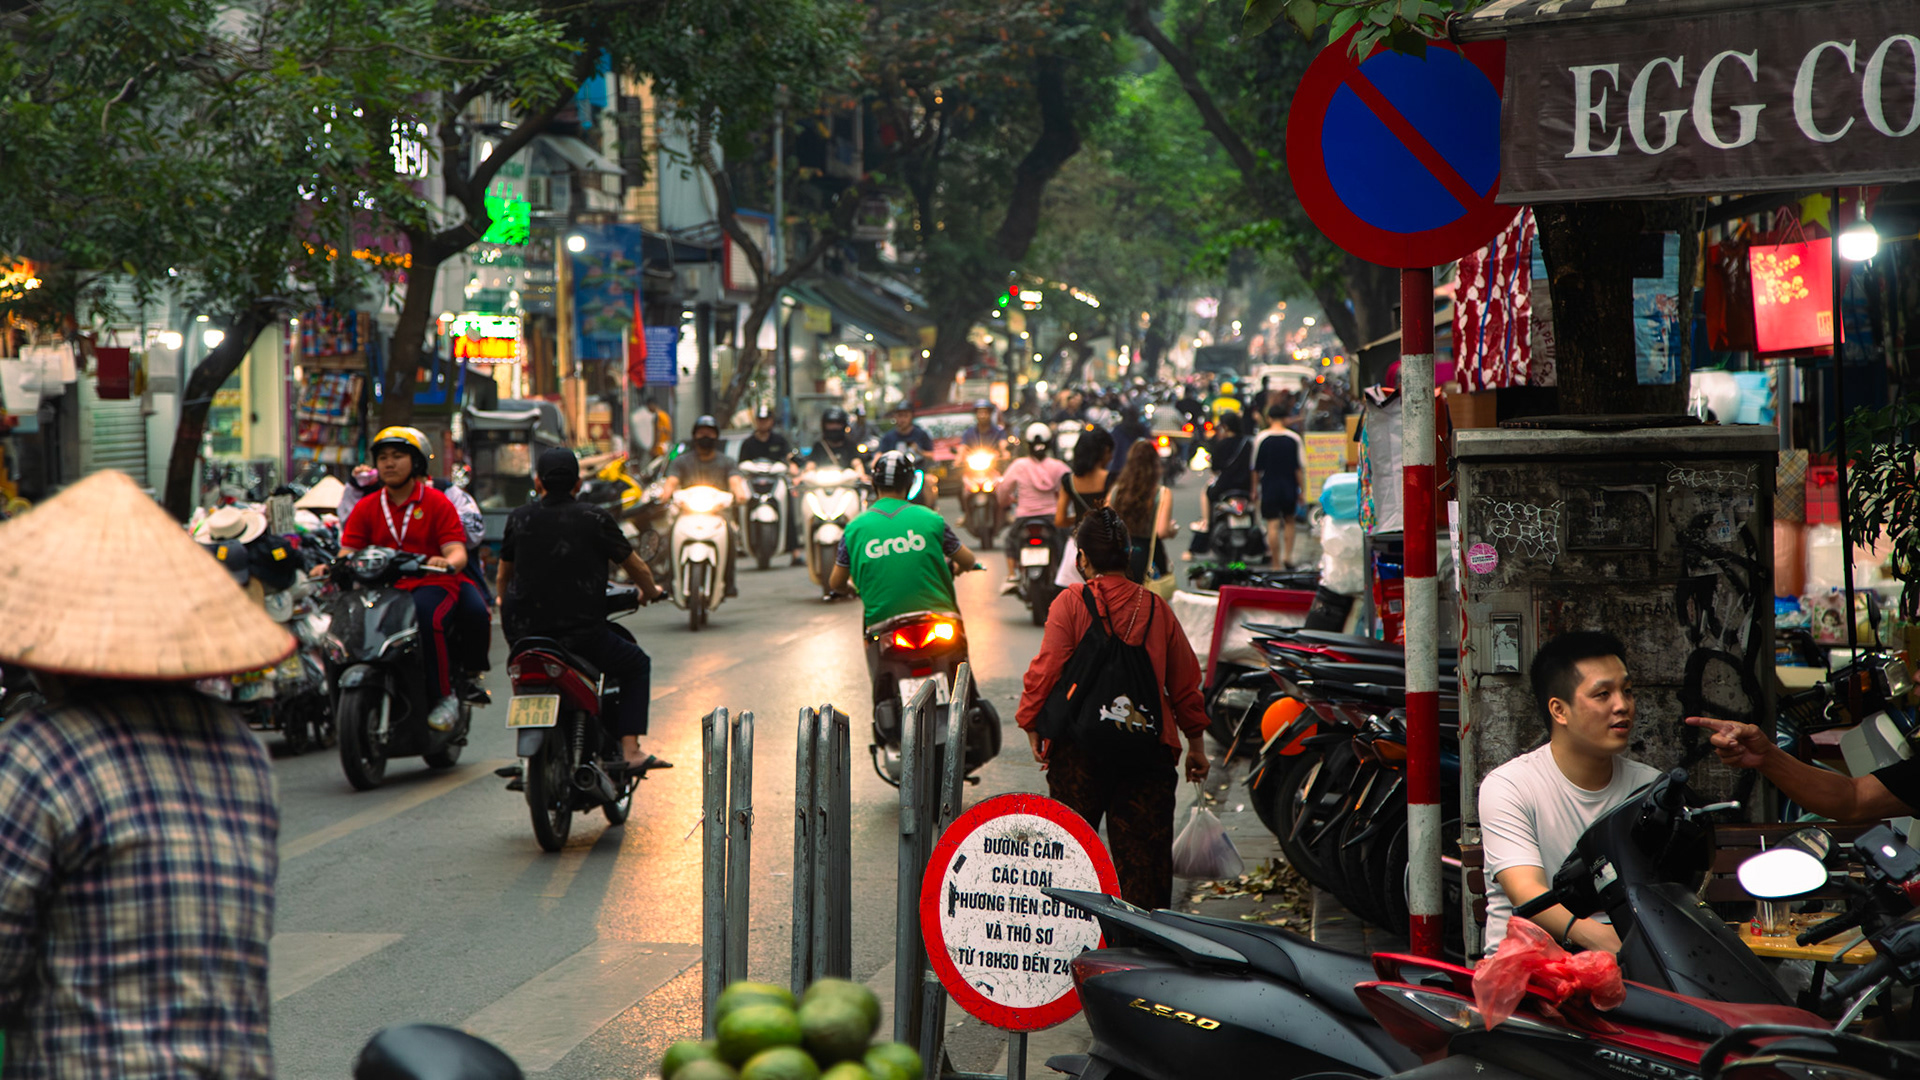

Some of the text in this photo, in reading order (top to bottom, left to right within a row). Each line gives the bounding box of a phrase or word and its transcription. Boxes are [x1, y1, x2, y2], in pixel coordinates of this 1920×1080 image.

[1565, 48, 1766, 158] EGG
[865, 529, 926, 559] Grab
[984, 836, 1064, 860] ĐƯỜNG CẤM
[992, 864, 1019, 884] CÁC
[954, 891, 1005, 912] PHƯƠNG
[1009, 894, 1038, 918] TIỆN
[986, 920, 1054, 945] VÀ THÔ SƠ
[958, 946, 975, 966] TỪ
[979, 950, 1019, 971] 18H30
[1022, 951, 1049, 974] ĐẾN
[1128, 998, 1221, 1031] LEAD
[1594, 1048, 1643, 1067] AIR
